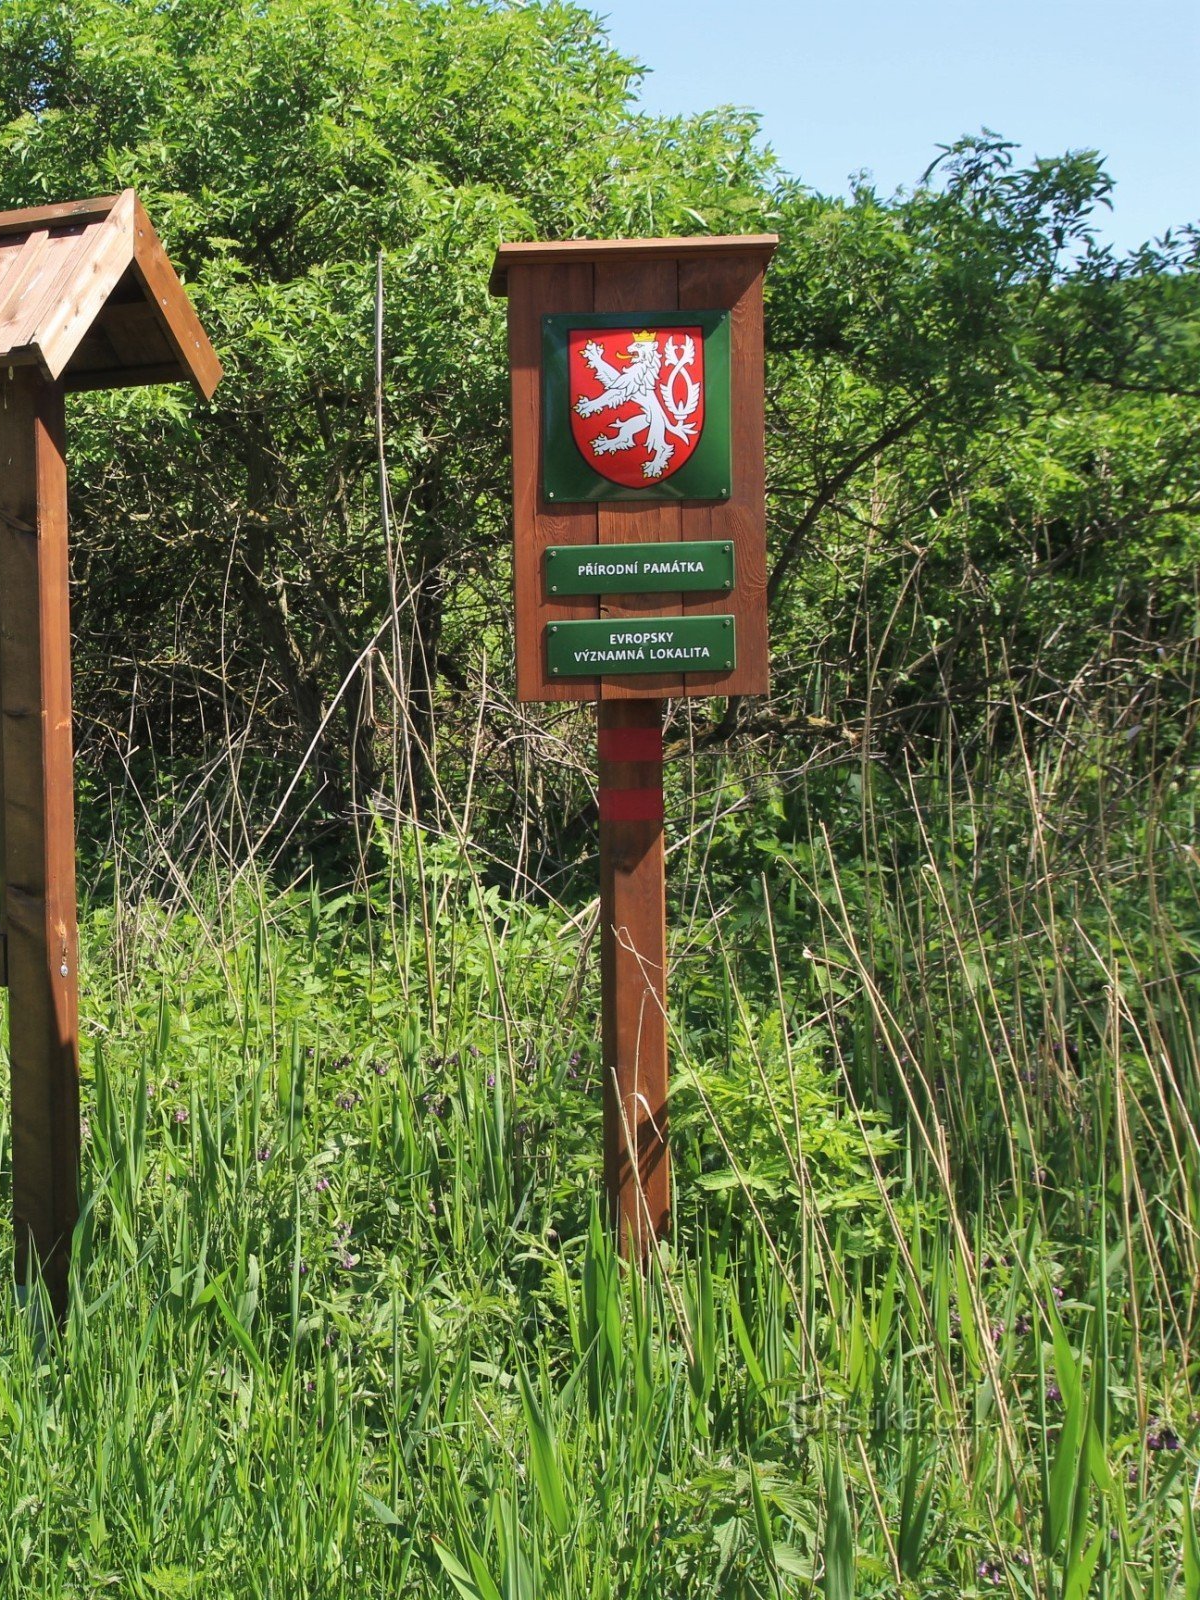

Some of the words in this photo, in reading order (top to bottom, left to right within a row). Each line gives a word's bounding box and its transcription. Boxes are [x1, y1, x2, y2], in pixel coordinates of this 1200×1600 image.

[578, 560, 638, 576] PŘÍRODNÍ
[643, 558, 704, 574] PAMÁTKA
[609, 632, 674, 645] EVROPSKY
[574, 647, 645, 663] VÝZNAMNÁ
[650, 647, 710, 660] LOKALITA
